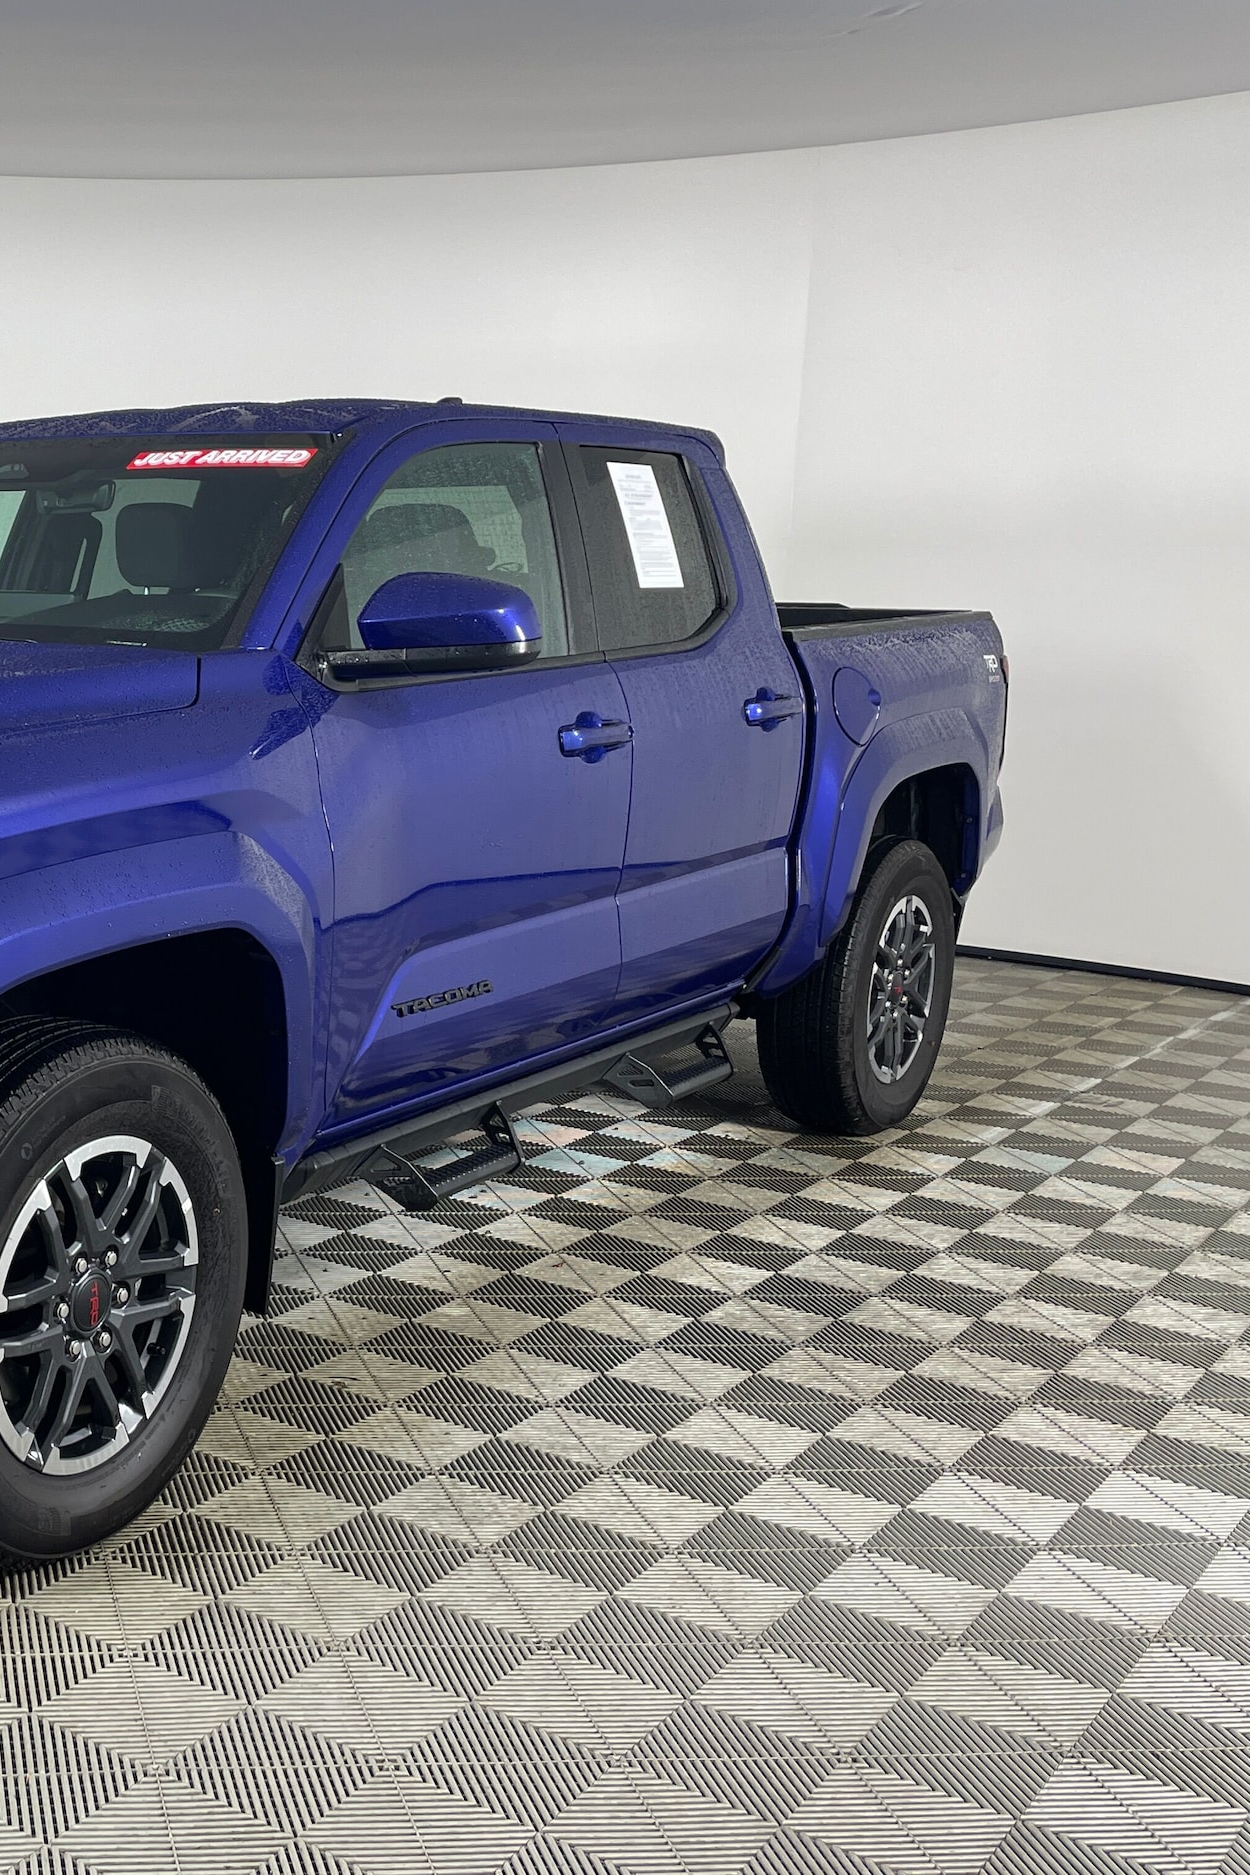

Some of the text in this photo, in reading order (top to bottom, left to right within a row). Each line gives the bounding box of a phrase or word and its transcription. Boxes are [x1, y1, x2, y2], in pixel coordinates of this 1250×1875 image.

[134, 449, 312, 465] JUST ARRIVED
[391, 980, 493, 1017] TACOMA
[90, 1282, 99, 1326] TRD
